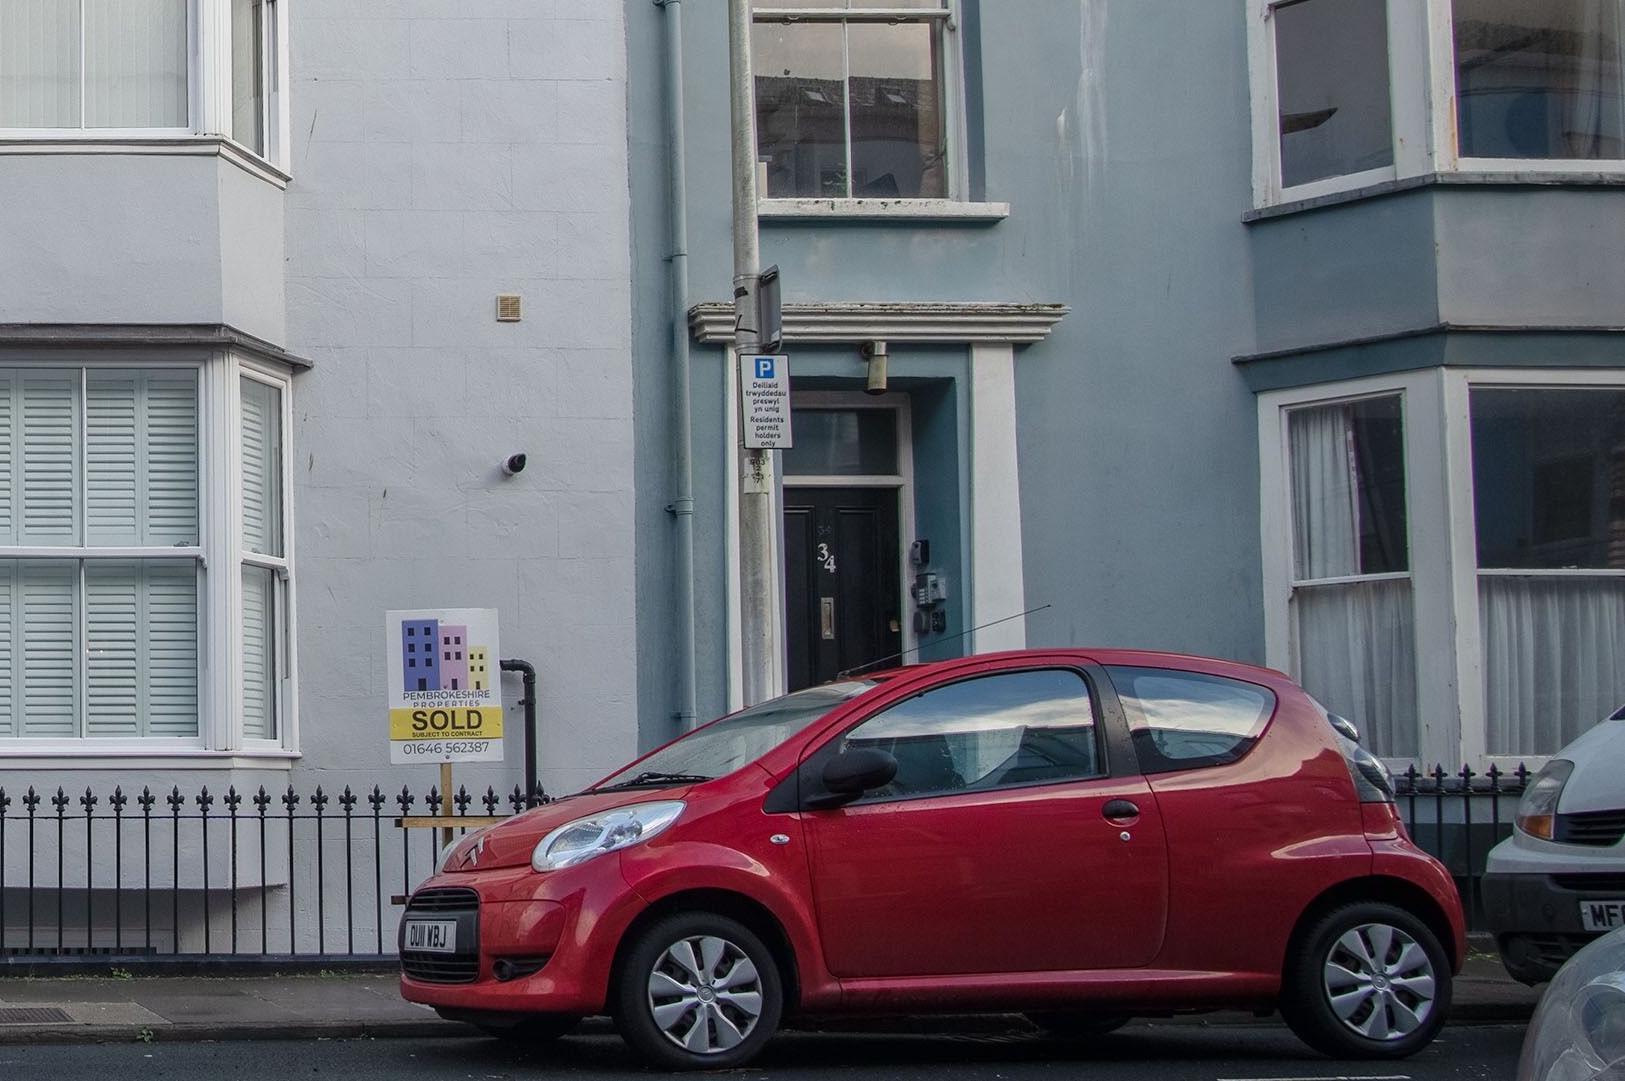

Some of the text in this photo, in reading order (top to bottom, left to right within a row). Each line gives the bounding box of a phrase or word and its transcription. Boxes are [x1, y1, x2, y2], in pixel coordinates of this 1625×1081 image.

[759, 360, 772, 377] P
[745, 390, 787, 398] trwyddedau
[752, 398, 780, 406] preswyl
[753, 406, 780, 414] yn unig
[750, 415, 785, 423] Residents
[755, 424, 780, 432] permit
[760, 440, 776, 448] only
[403, 689, 491, 701] PEMBROKESHIRE
[413, 699, 481, 708] PROPERTIES
[412, 709, 483, 731] SOLD
[403, 741, 489, 755] 01646 562387
[427, 924, 447, 948] WBJ
